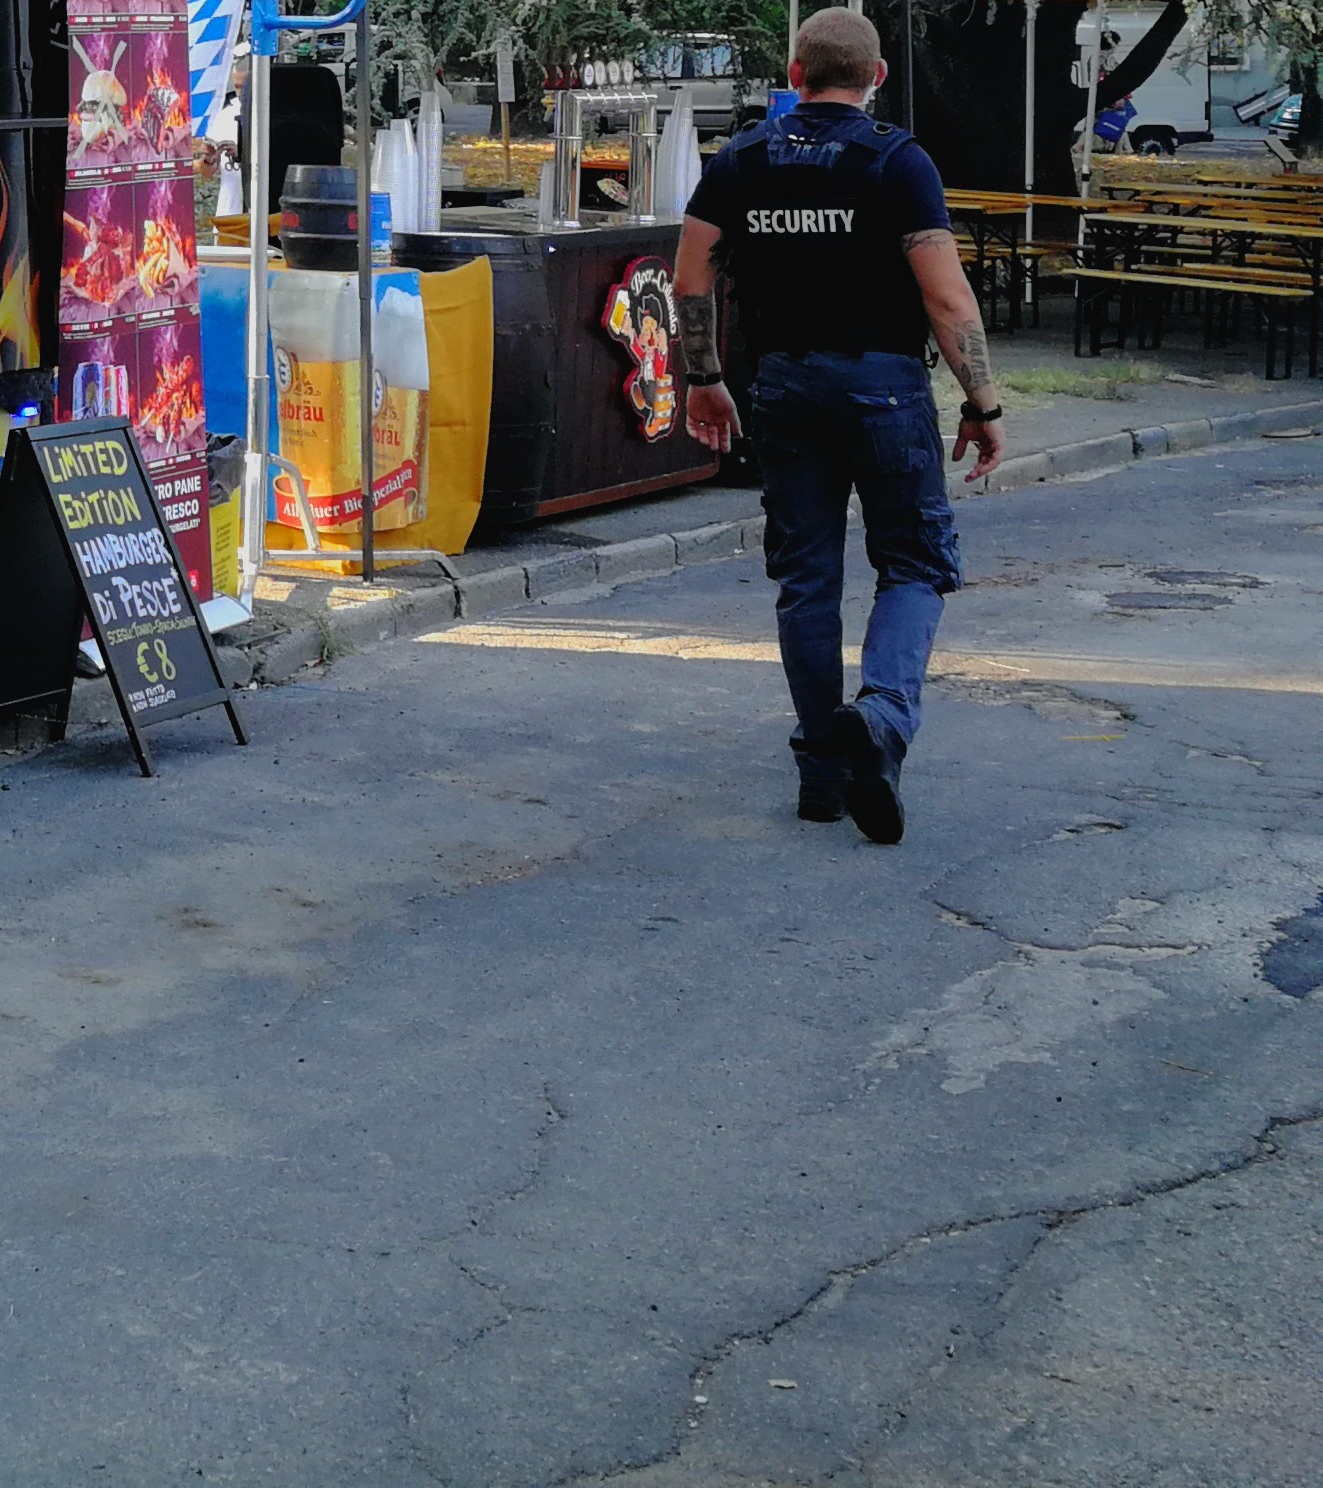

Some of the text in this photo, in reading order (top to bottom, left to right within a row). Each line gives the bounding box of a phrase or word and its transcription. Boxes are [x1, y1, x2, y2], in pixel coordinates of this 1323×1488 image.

[746, 209, 855, 234] SECURITY
[174, 475, 202, 497] PANE
[163, 499, 200, 521] RESCO
[74, 526, 174, 578] HAMBURGER
